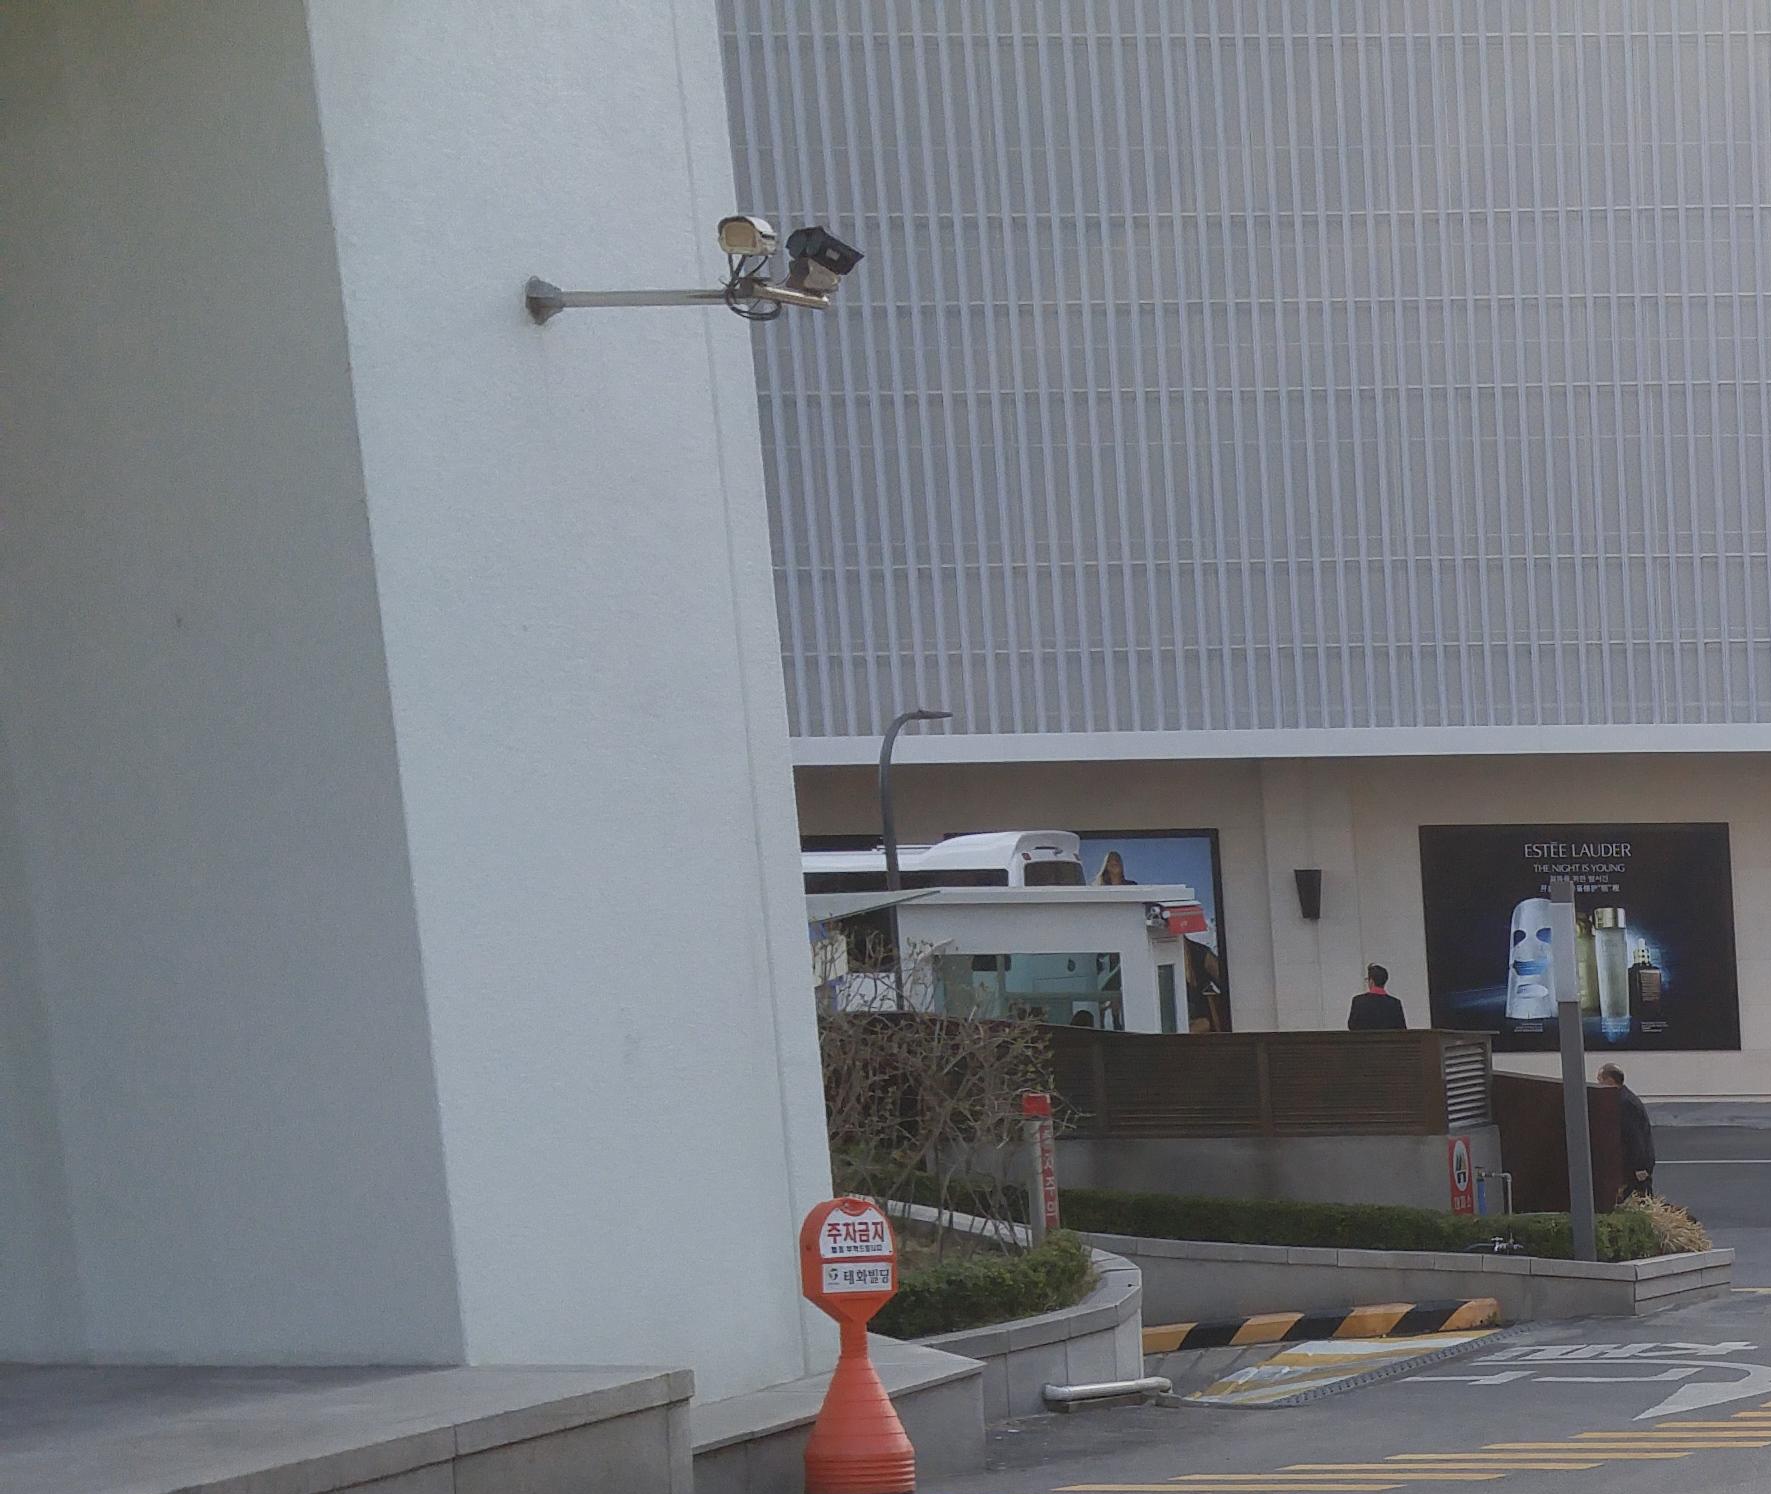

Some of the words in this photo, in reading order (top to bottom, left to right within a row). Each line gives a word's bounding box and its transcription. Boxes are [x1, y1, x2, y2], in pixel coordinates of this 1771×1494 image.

[1572, 843, 1632, 858] LAUDER
[1533, 864, 1550, 873] THE
[1551, 863, 1580, 873] NIGHT
[1582, 863, 1590, 872] IS
[1591, 863, 1626, 873] YOUNG
[827, 1221, 885, 1244] 주차금지
[843, 1268, 889, 1285] 태화빌딩
